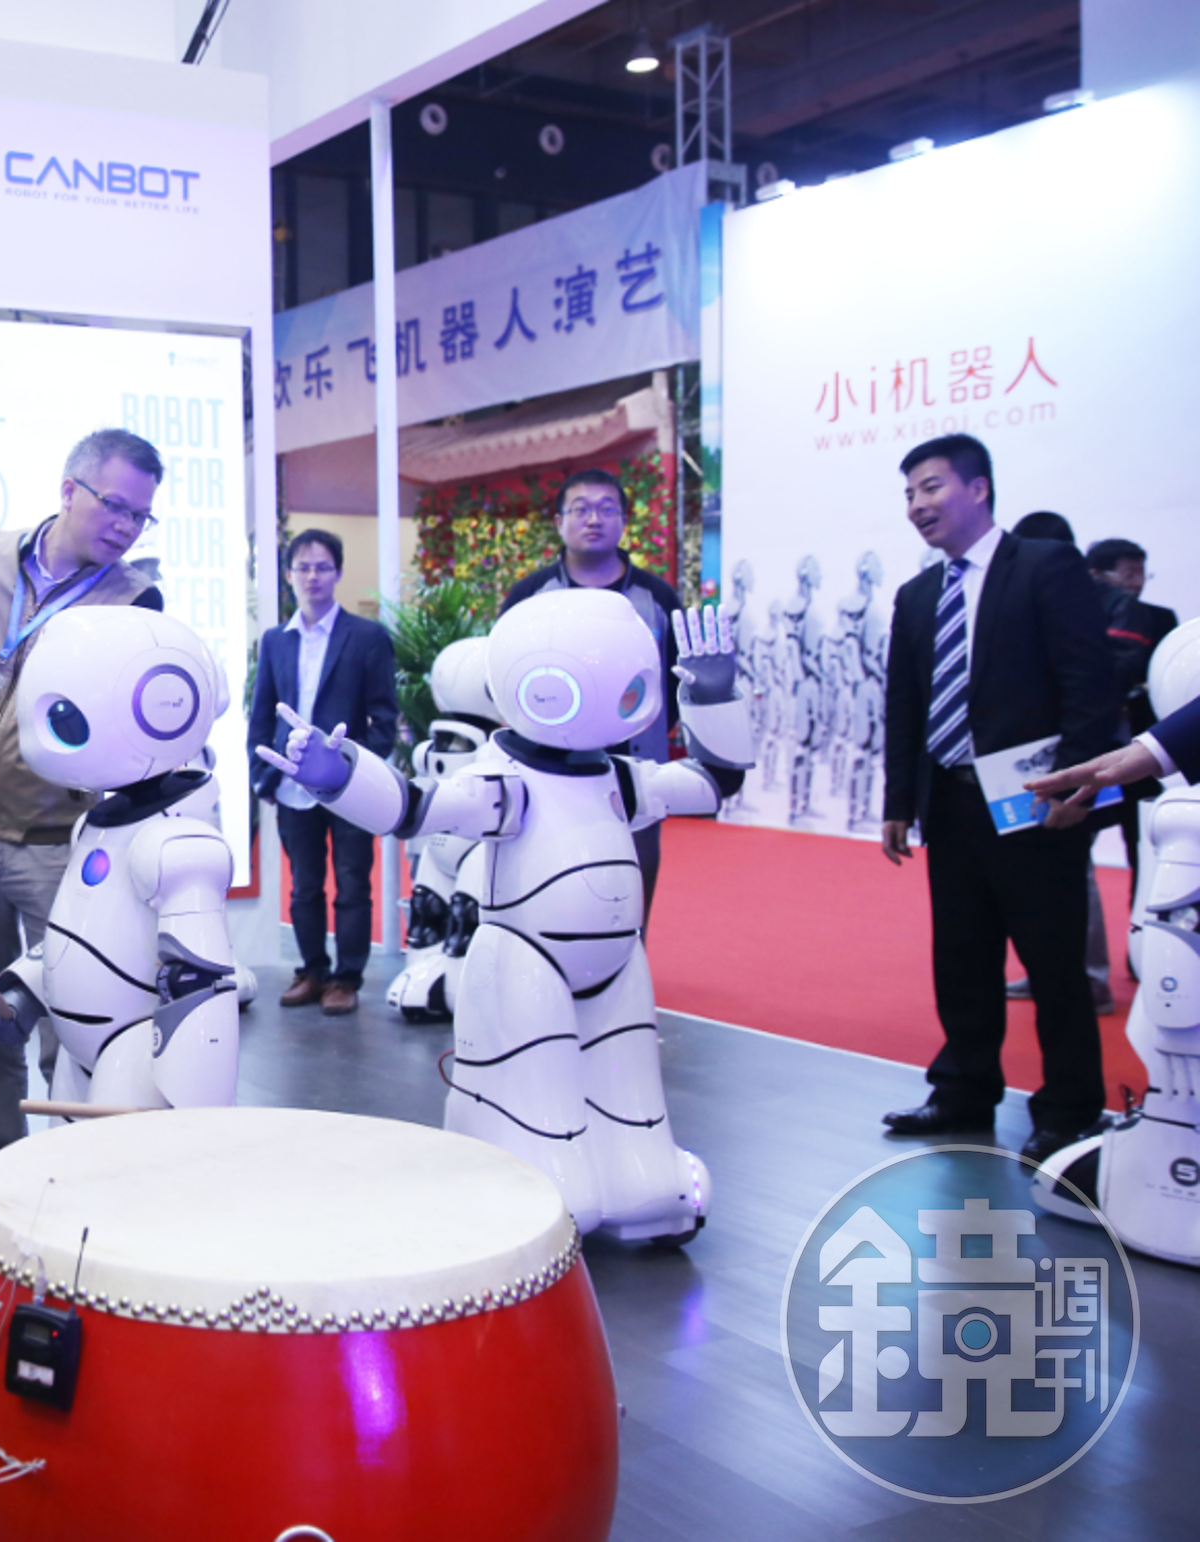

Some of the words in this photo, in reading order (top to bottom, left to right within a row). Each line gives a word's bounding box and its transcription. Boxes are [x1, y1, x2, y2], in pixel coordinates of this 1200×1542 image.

[4, 187, 48, 200] ROBOT
[53, 192, 79, 203] FOR
[84, 195, 118, 207] YOUR
[124, 199, 170, 212] BETTER
[175, 204, 200, 215] LIFE
[5, 150, 200, 201] CANBOT
[814, 336, 1058, 422] 小i机器人
[121, 391, 224, 449] ROBOT
[168, 455, 225, 509] FOR
[166, 516, 225, 569] OUR
